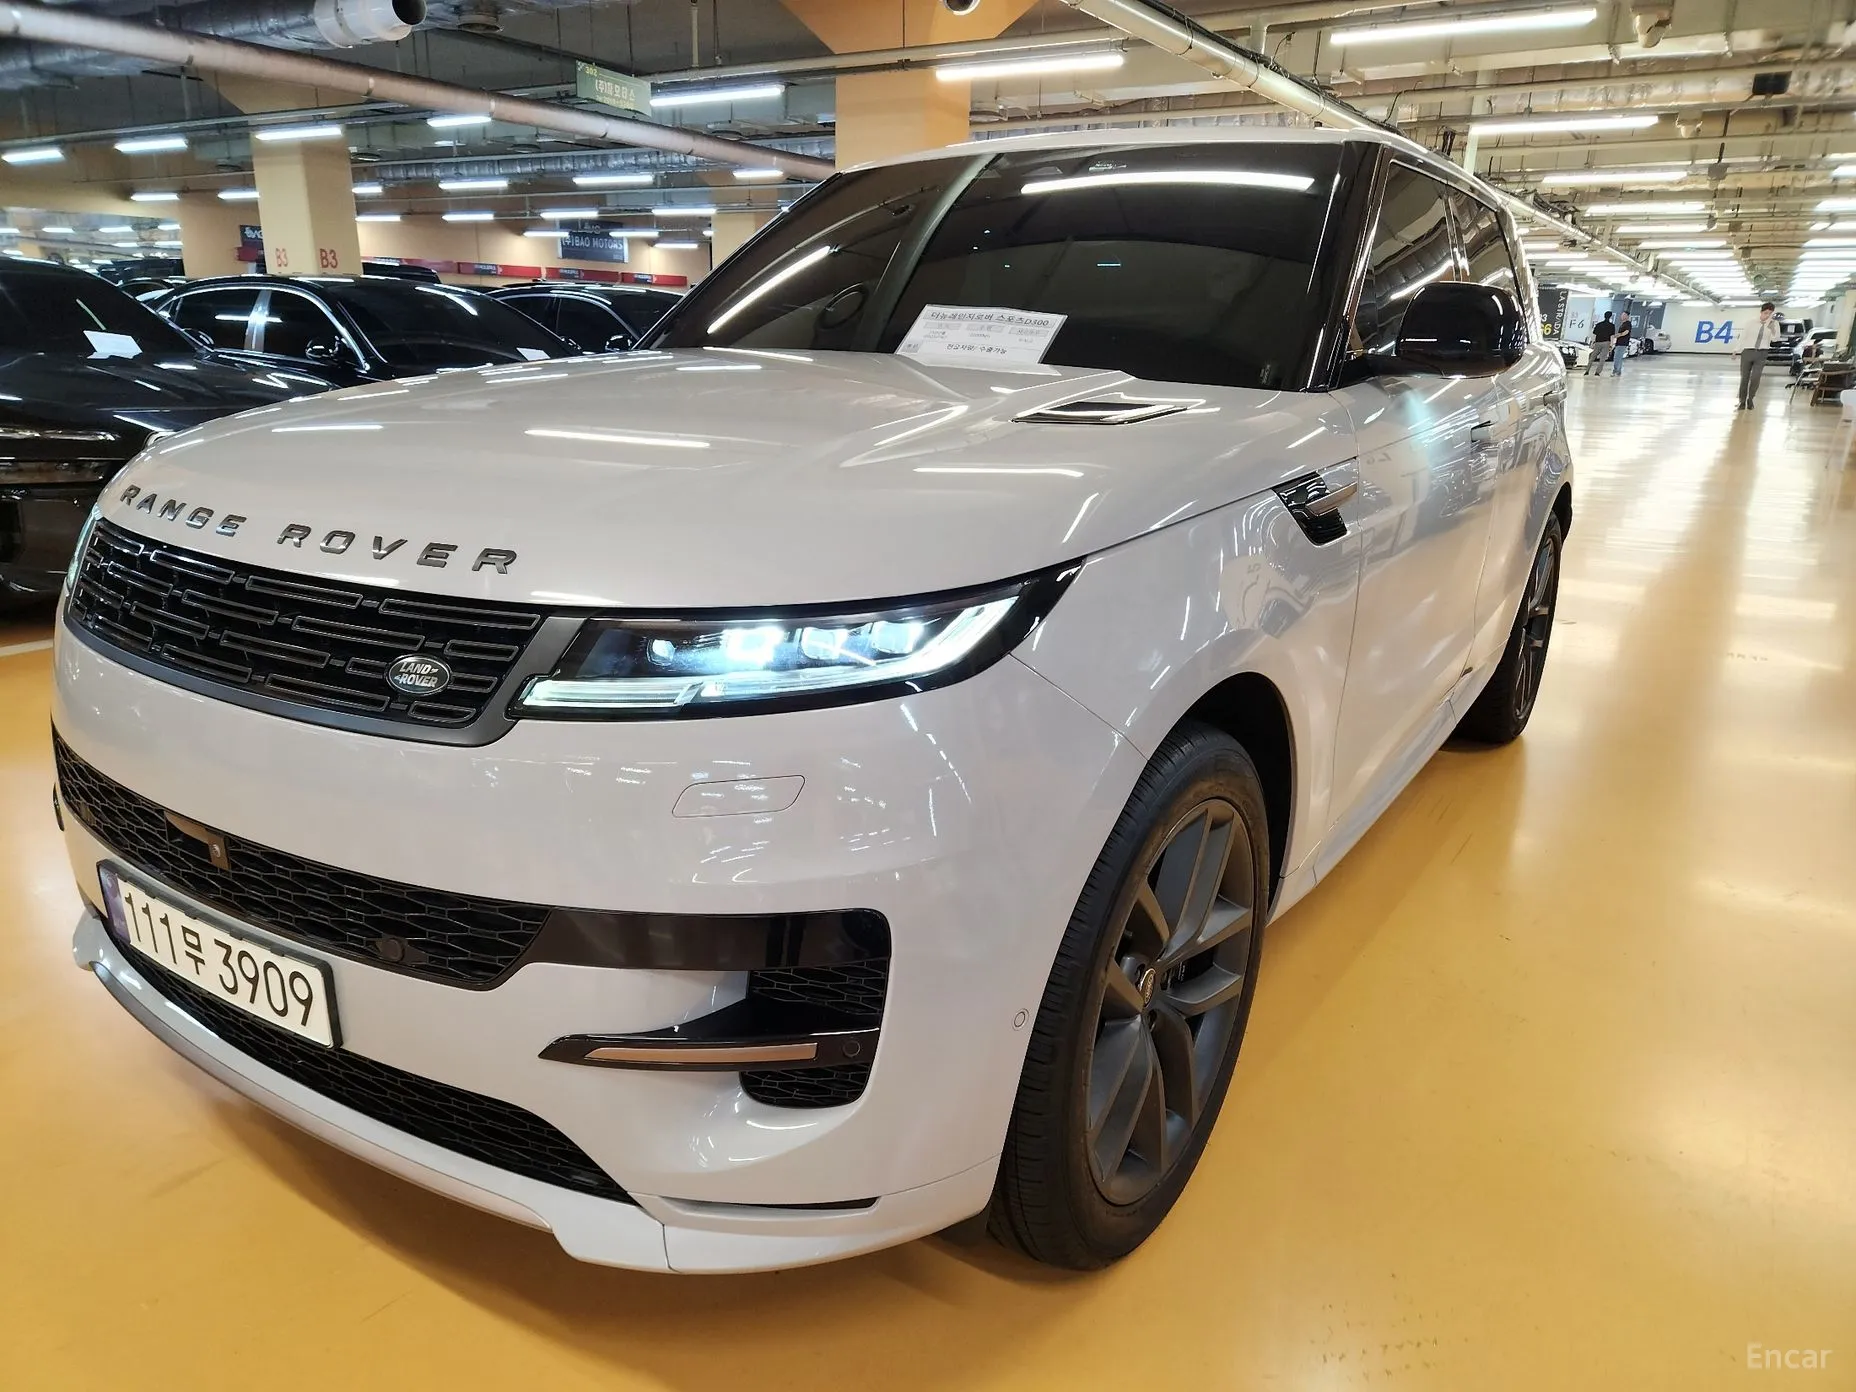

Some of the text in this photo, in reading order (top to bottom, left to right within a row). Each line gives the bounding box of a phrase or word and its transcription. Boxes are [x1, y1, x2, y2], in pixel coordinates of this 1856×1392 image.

[592, 237, 624, 250] MOTORS
[319, 247, 339, 269] B3
[1552, 302, 1566, 336] STRADA
[1569, 319, 1585, 329] F6
[1694, 320, 1734, 344] B4
[119, 484, 518, 575] RANGE ROVER
[400, 661, 432, 675] LAND
[399, 673, 438, 688] ROVER
[124, 892, 314, 1027] 111무 3909
